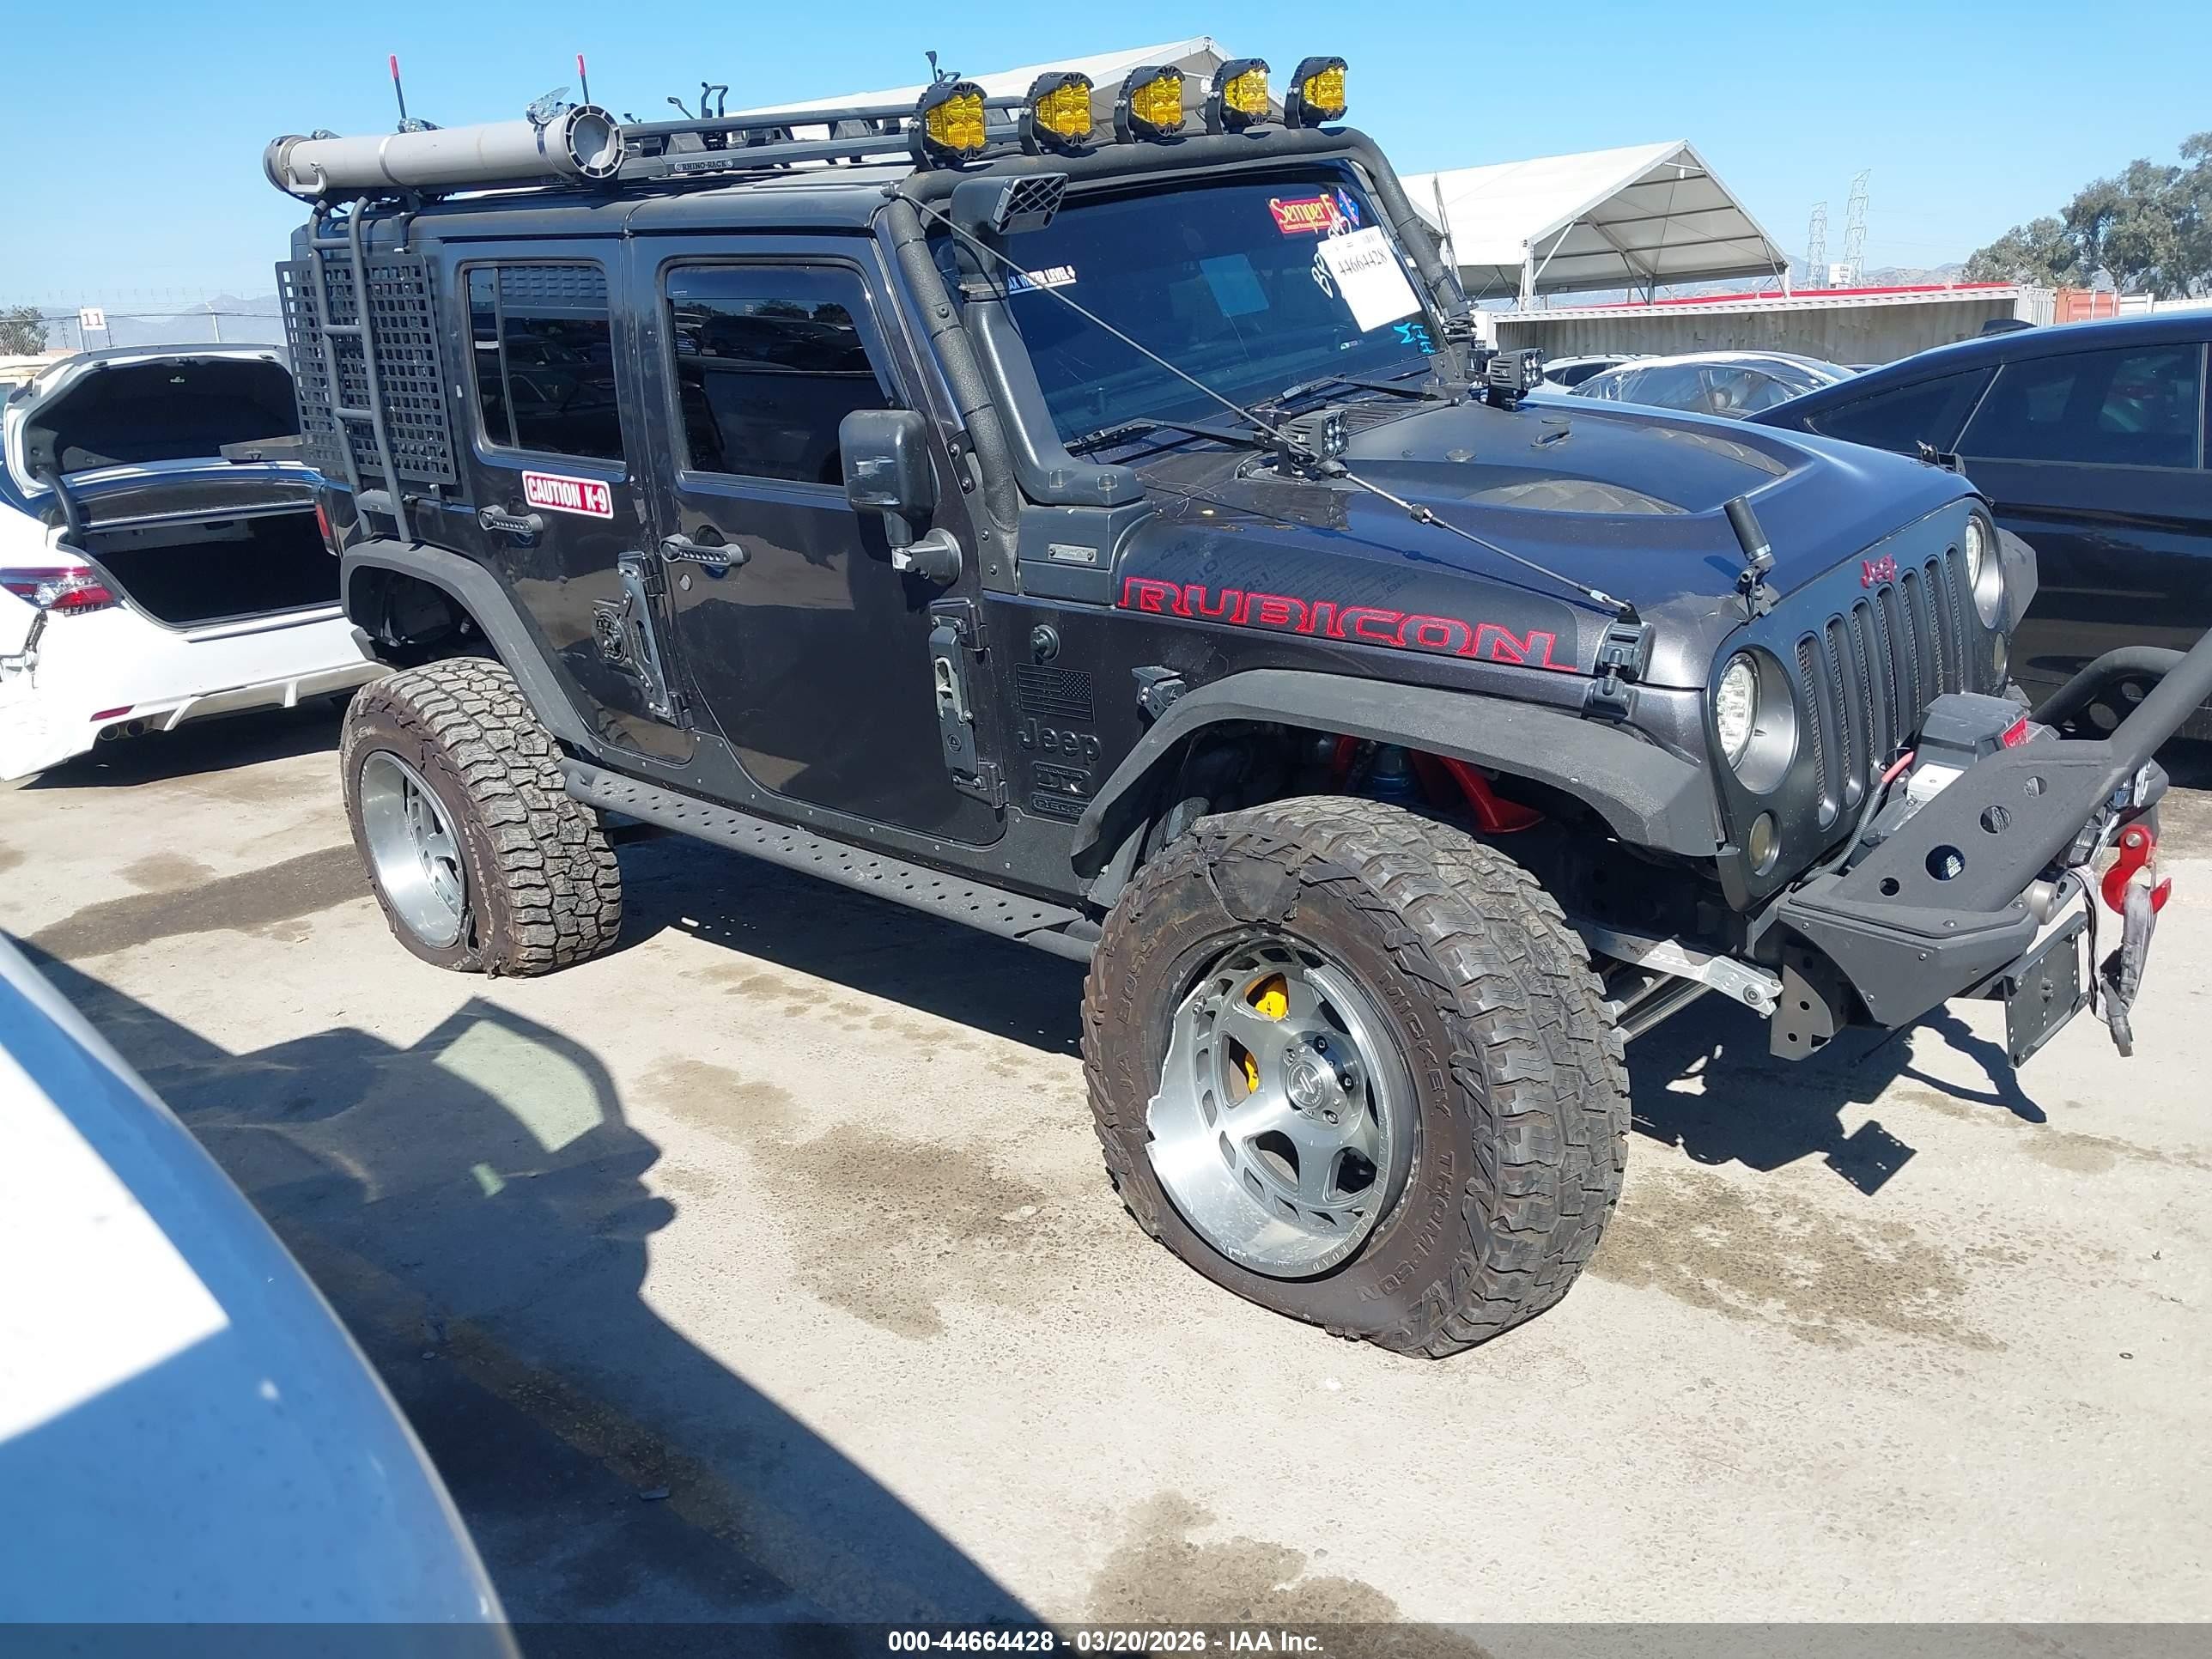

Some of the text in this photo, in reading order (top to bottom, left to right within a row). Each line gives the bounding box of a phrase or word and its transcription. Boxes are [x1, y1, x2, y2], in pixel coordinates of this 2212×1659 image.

[683, 160, 726, 171] RHINO-RACK
[1270, 198, 1325, 234] Semper
[1008, 276, 1020, 291] AX
[1044, 266, 1070, 283] LEVEL
[83, 313, 104, 326] 11
[526, 477, 608, 512] CAUTION K-9
[1117, 575, 1578, 673] RUBICON
[1017, 717, 1102, 767] Jeep
